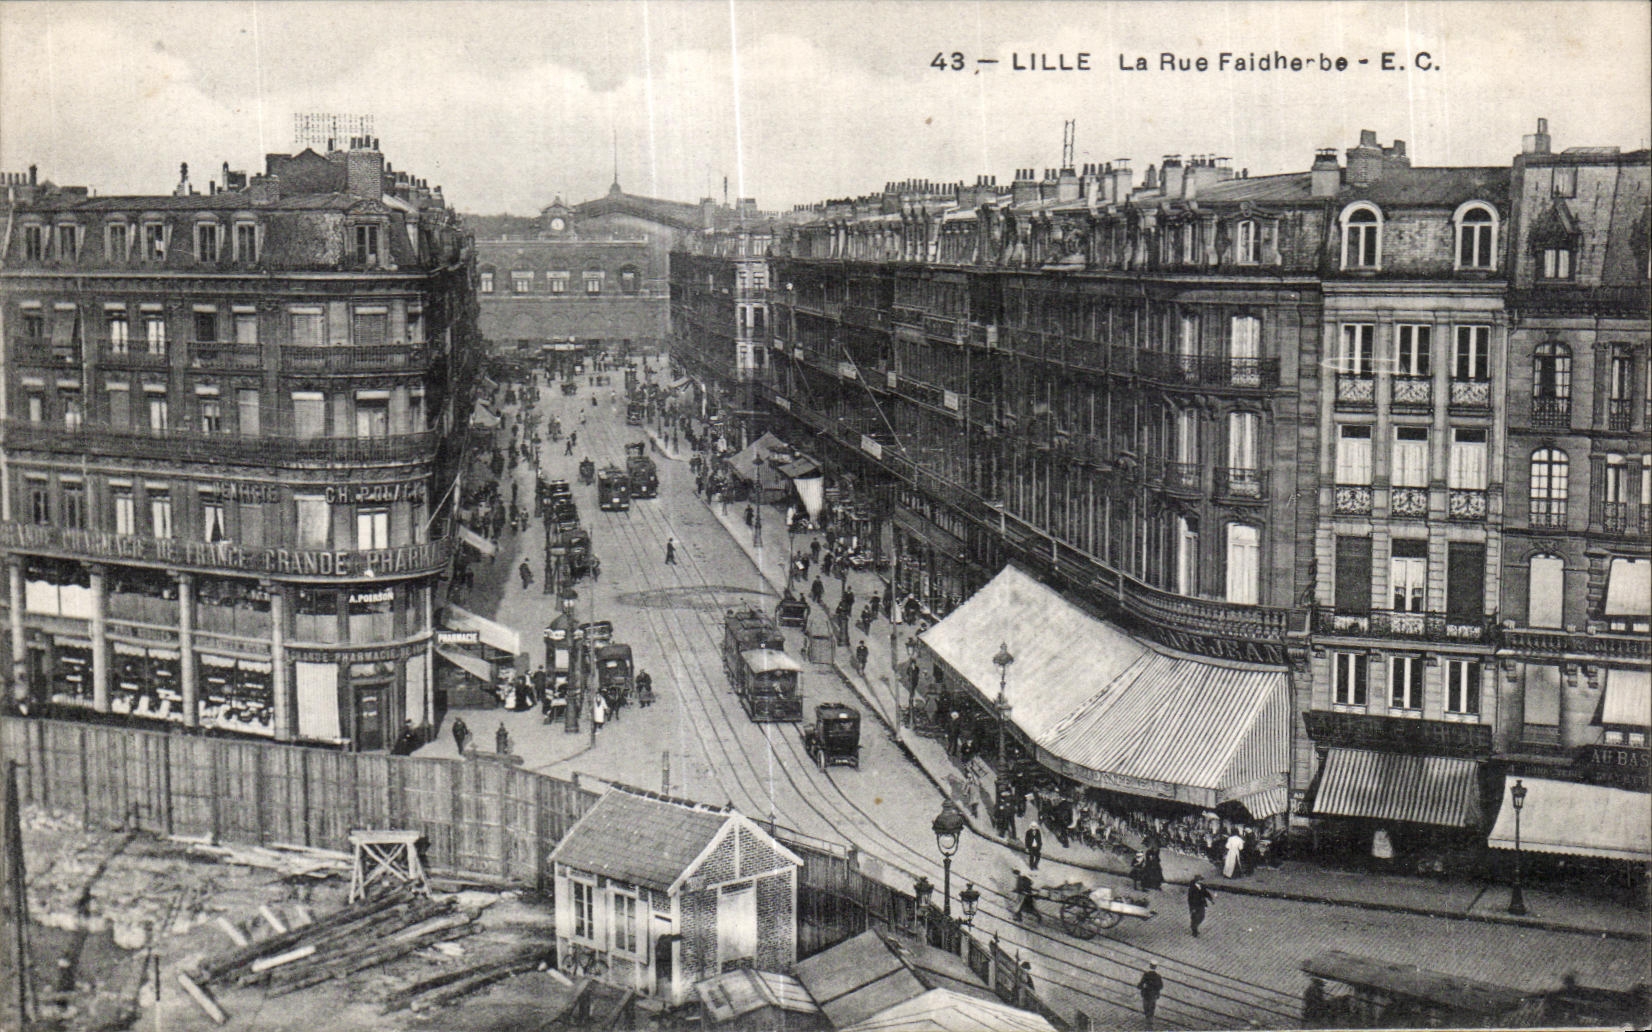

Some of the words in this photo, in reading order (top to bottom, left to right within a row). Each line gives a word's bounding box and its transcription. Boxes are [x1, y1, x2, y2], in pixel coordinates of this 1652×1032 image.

[186, 541, 246, 568] FRANCE
[264, 547, 348, 575] GRANDE
[335, 646, 397, 662] PHARMACIE
